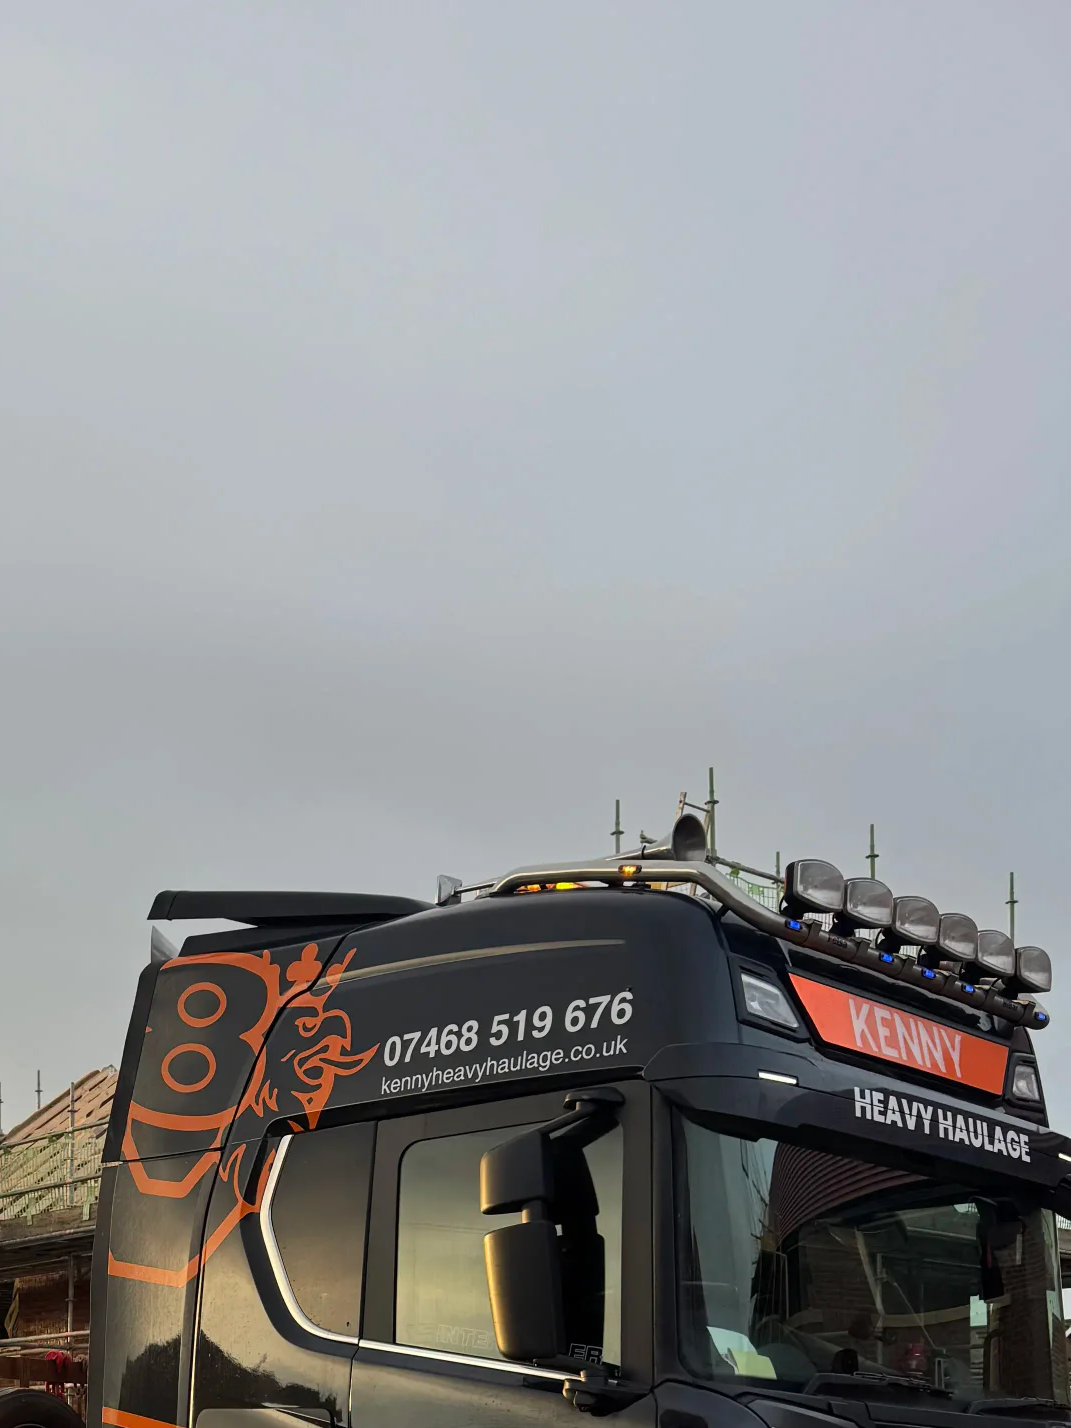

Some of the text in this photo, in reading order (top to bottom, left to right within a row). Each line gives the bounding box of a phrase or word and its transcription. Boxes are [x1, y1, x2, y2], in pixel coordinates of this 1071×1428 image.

[381, 1035, 629, 1095] kennyheavyhaulage.co.uk
[383, 991, 634, 1067] 07468 519 676
[848, 998, 963, 1078] KENNY
[854, 1086, 1031, 1162] HEAVY HAULAGE
